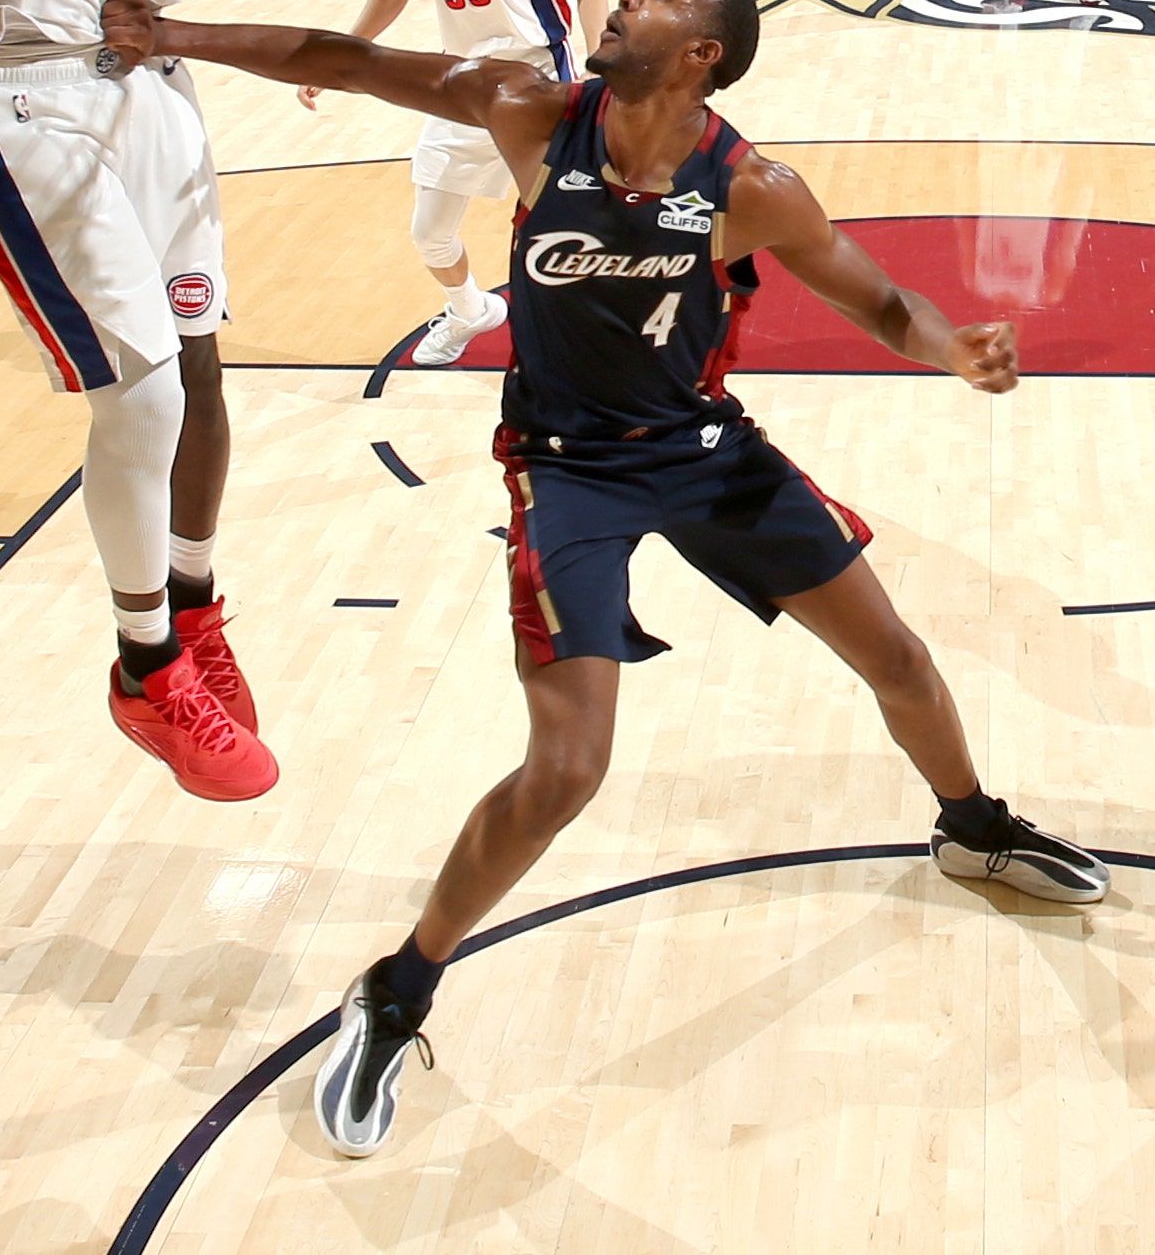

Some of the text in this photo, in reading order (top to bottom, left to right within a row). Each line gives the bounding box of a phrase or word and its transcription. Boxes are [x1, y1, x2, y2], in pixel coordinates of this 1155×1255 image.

[565, 168, 597, 187] NIKE
[659, 213, 710, 232] CLIFFS
[524, 230, 697, 287] CLEVELAND
[640, 291, 683, 348] 4
